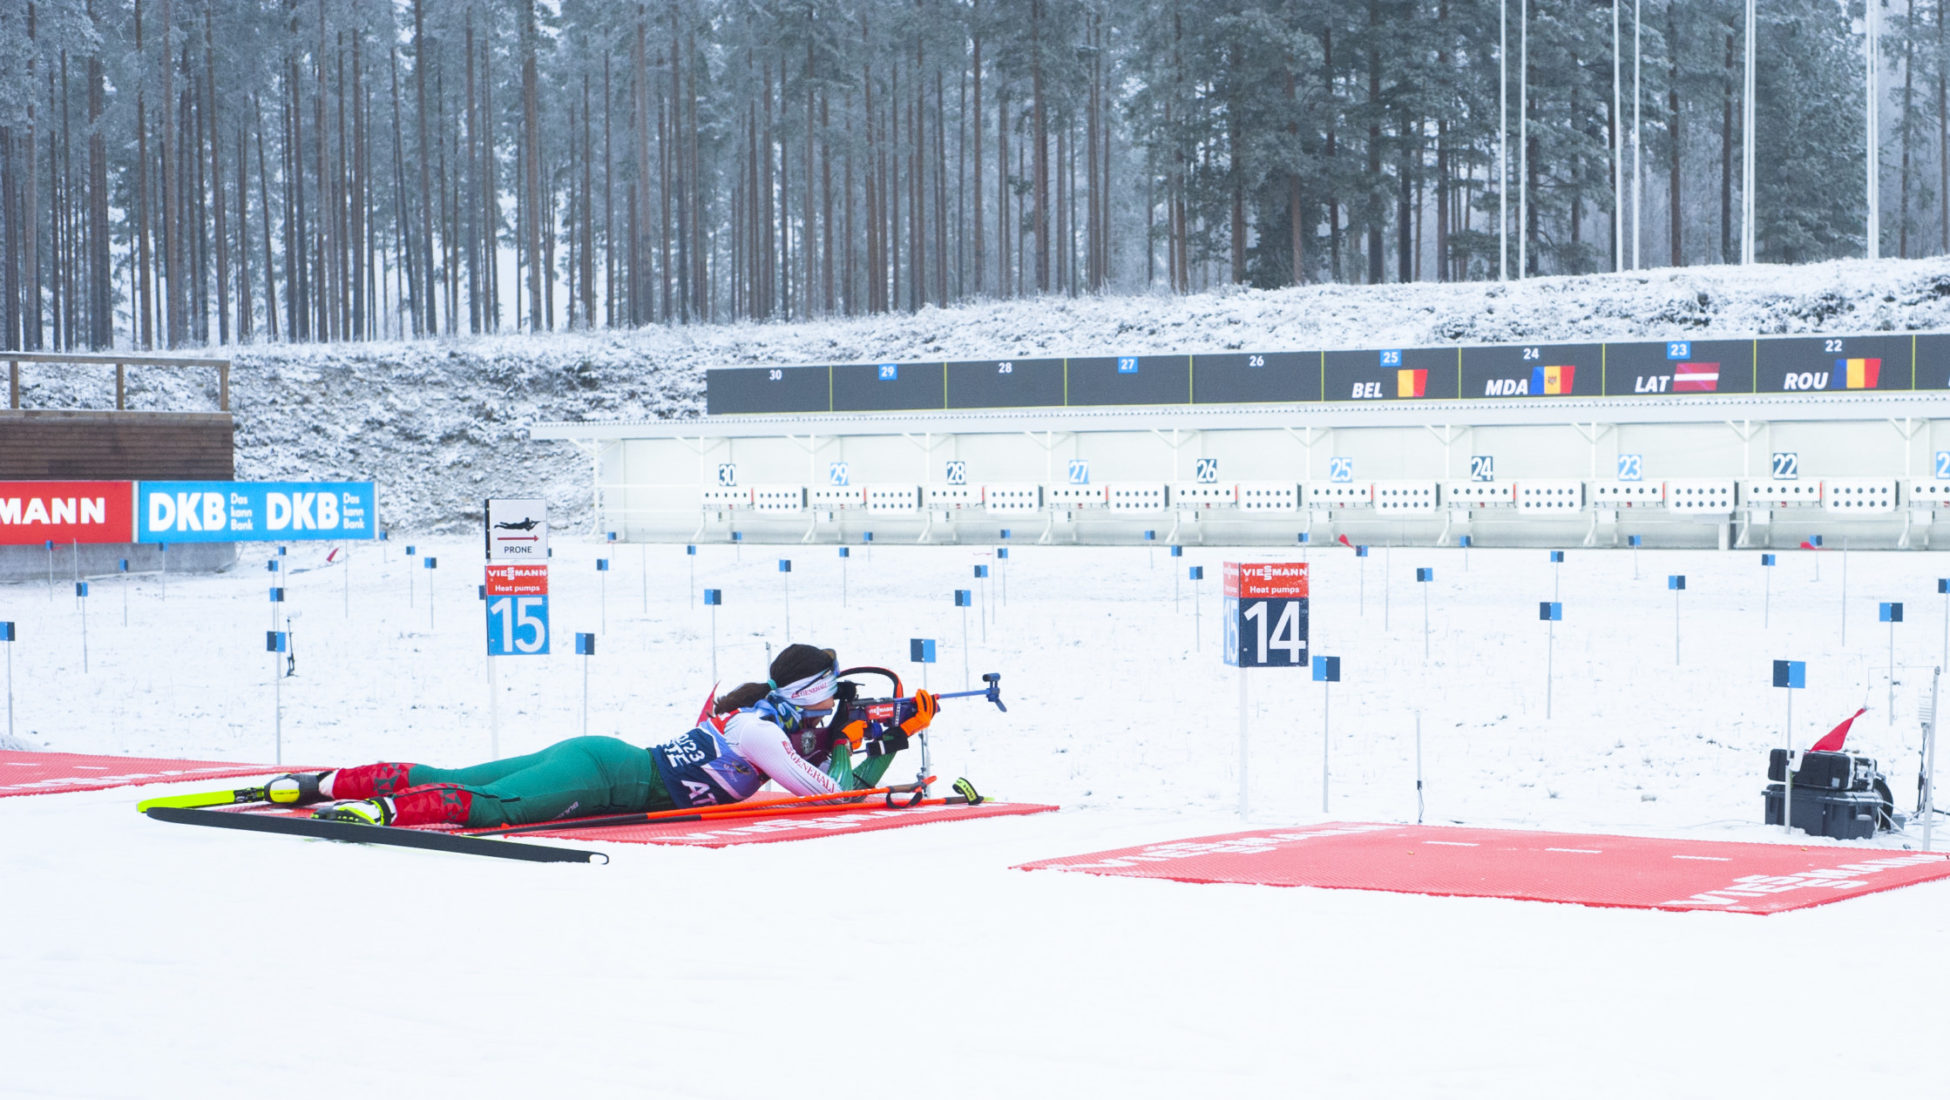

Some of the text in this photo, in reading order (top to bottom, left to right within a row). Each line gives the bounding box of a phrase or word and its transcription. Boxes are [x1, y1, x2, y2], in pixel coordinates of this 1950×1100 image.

[1671, 345, 1687, 357] 23
[1825, 340, 1843, 352] 22
[1249, 355, 1265, 367] 26
[1383, 352, 1398, 364] 25
[1523, 348, 1540, 360] 24
[881, 366, 895, 378] 29
[998, 363, 1012, 374] 28
[1121, 359, 1135, 371] 27
[769, 369, 782, 380] 30
[1784, 372, 1829, 390] ROU
[1352, 382, 1383, 398] BEL
[1485, 379, 1529, 396] MDA
[1634, 376, 1670, 393] LAT
[947, 463, 965, 485] 28
[1070, 462, 1088, 483] 27
[1197, 460, 1217, 483] 26
[1331, 459, 1352, 482] 25
[1471, 457, 1493, 481] 24
[1619, 456, 1642, 480] 23
[1773, 454, 1797, 479] 22
[719, 465, 736, 486] 30
[831, 464, 848, 485] 29
[231, 493, 248, 505] Das
[343, 492, 359, 504] Das
[0, 498, 105, 524] MANN
[149, 493, 226, 532] DKB
[231, 507, 253, 518] kann
[266, 492, 340, 530] DKB
[343, 505, 364, 517] kann
[231, 519, 253, 531] Bank
[343, 518, 365, 530] Bank
[488, 567, 547, 580] VIESSMANN
[1243, 565, 1307, 580] VIESSMANN
[515, 585, 540, 593] pumps
[1271, 586, 1299, 594] pumps
[490, 597, 545, 652] 15
[1244, 601, 1306, 663] 14
